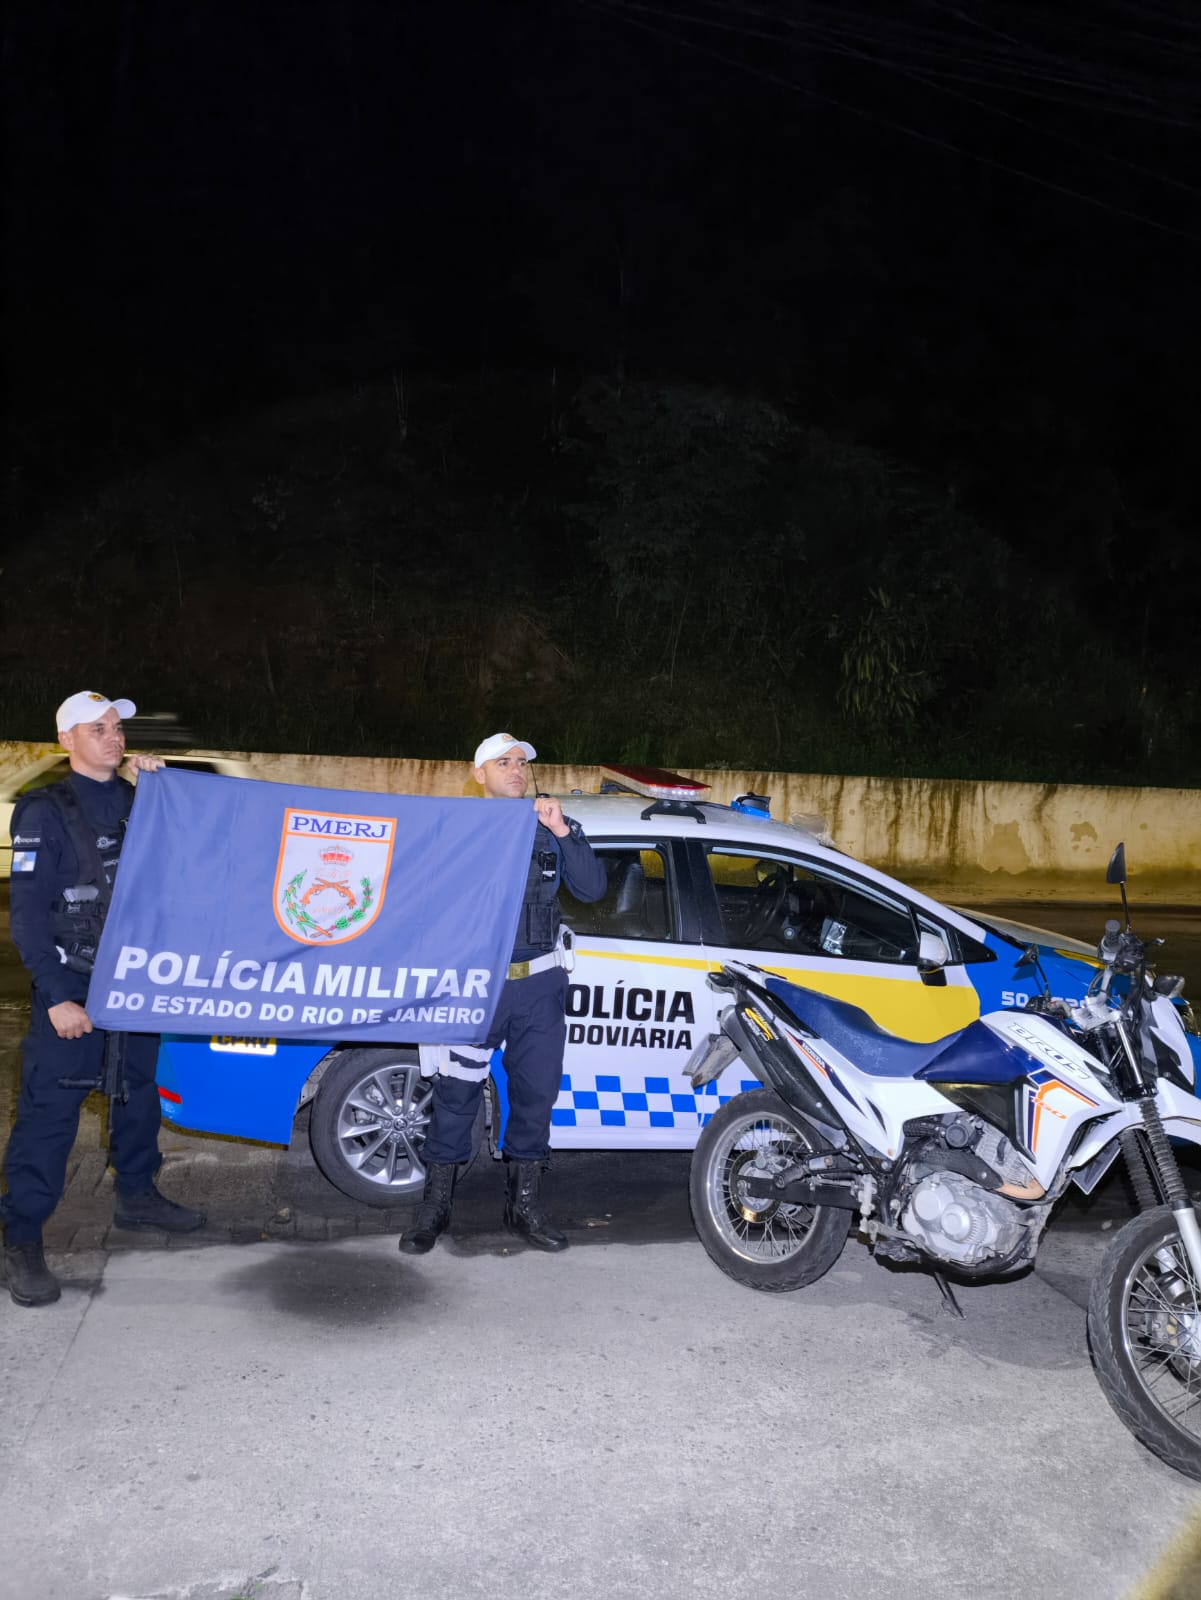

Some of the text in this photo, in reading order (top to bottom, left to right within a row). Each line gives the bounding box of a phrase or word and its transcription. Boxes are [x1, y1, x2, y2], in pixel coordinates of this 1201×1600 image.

[291, 816, 388, 838] PMERJ
[113, 946, 491, 998] POLÍCIA MILITAR
[106, 992, 485, 1024] DO ESTADO DO RIO DE JANEIRO
[565, 980, 695, 1024] OLÍCIA
[564, 1022, 693, 1050] DOVIÁRIA
